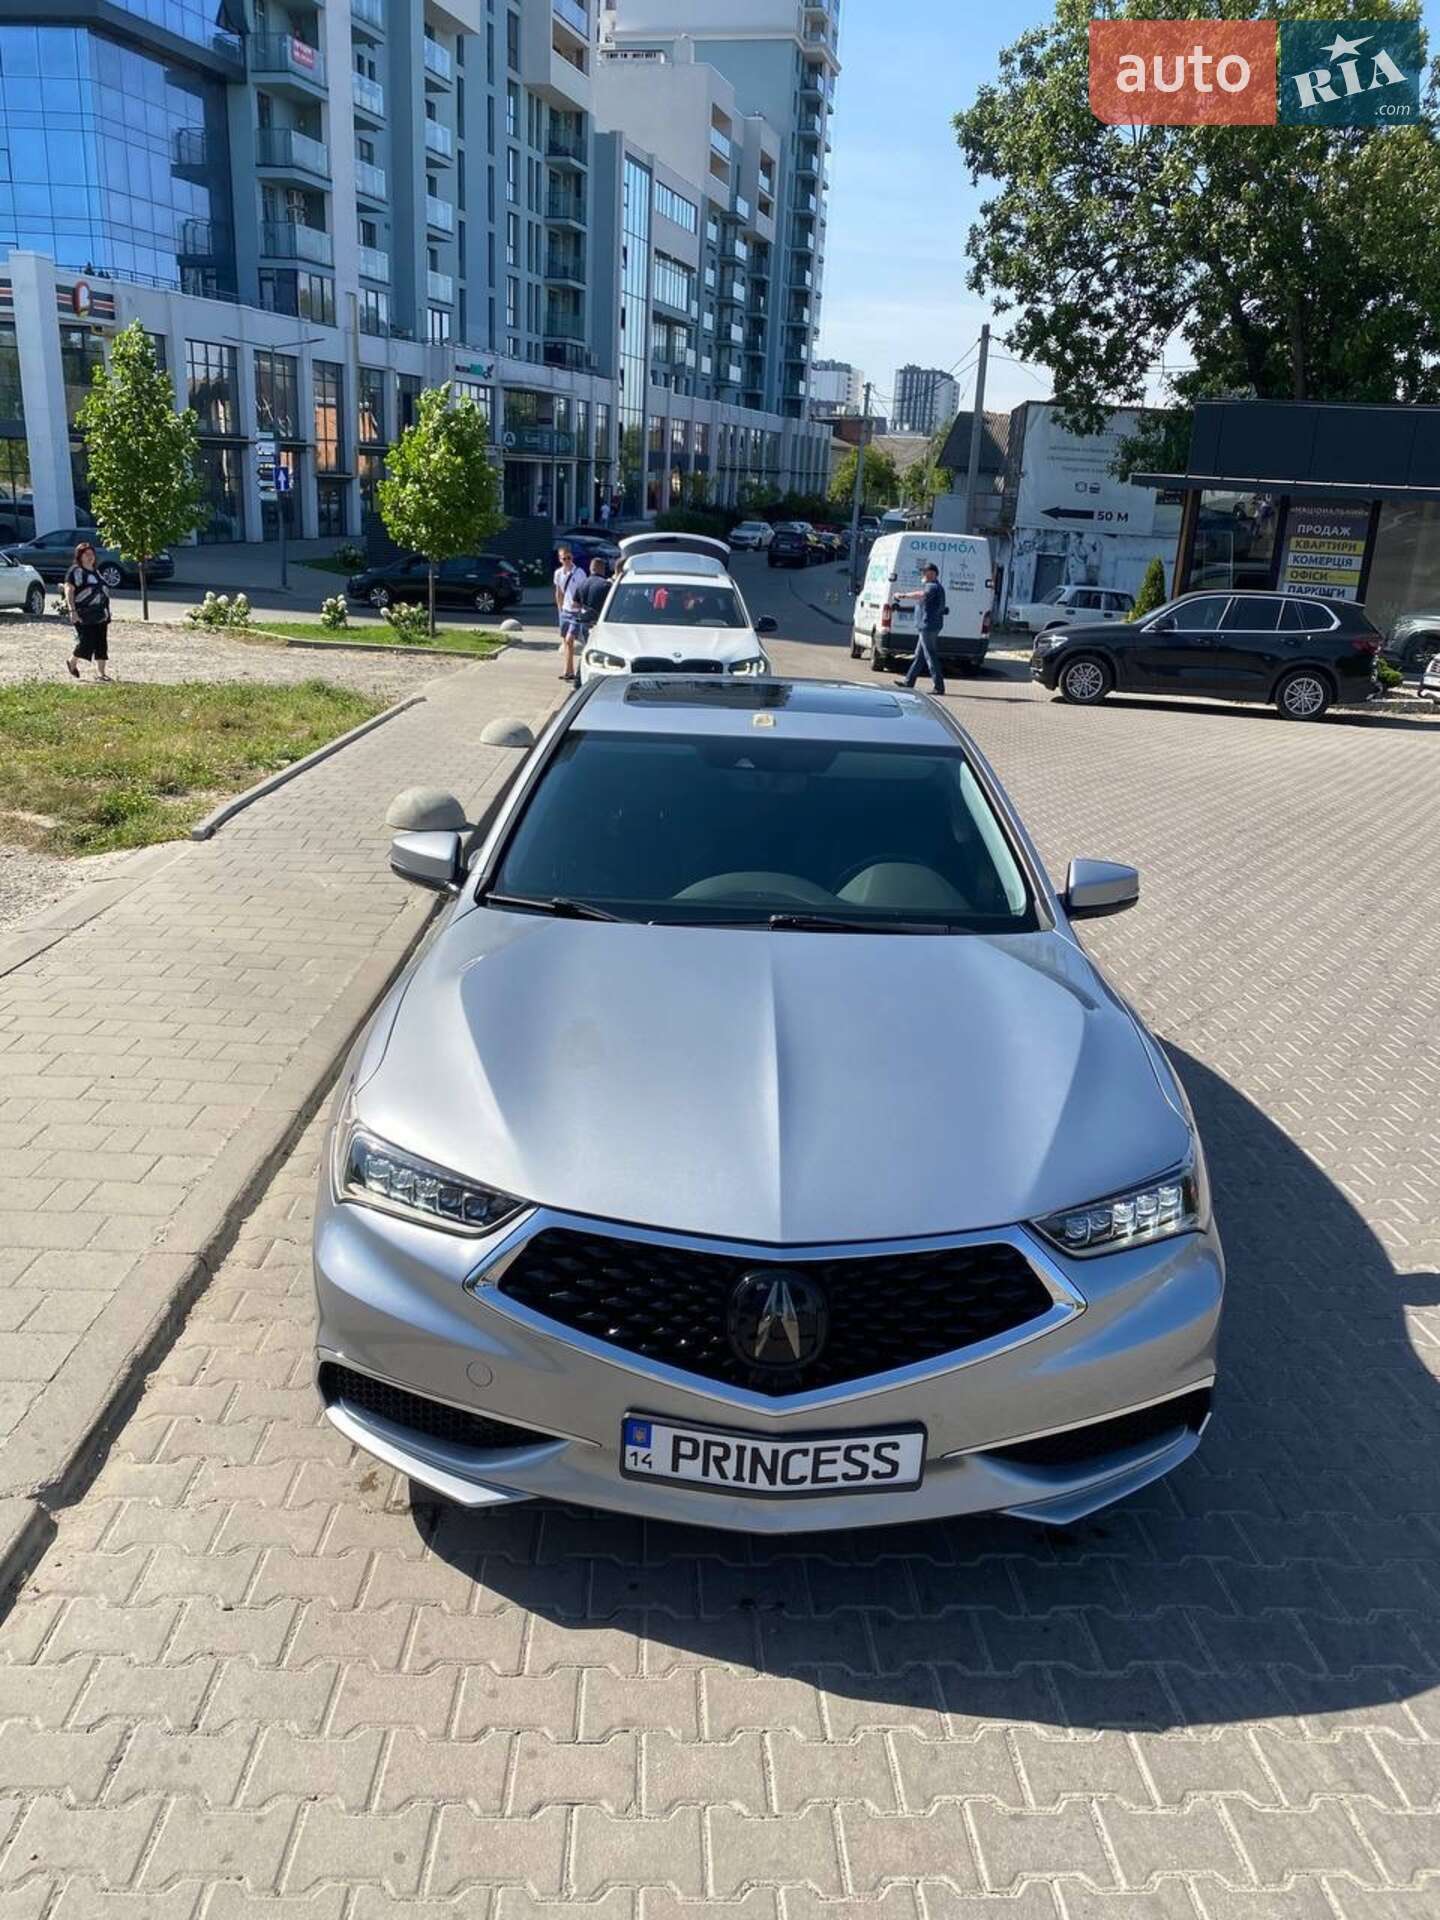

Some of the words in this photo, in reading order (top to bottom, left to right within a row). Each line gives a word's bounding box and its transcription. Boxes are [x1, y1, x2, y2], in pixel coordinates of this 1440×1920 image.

[1097, 511, 1113, 521] 50
[1297, 524, 1351, 537] ПРОДАЖ
[1295, 540, 1357, 552] КВАРТИРИ
[1292, 554, 1353, 567] КОМЕРЦІЯ
[1290, 570, 1328, 581] ОФІСИ
[630, 1451, 652, 1469] 14
[671, 1434, 901, 1486] PRINCESS
